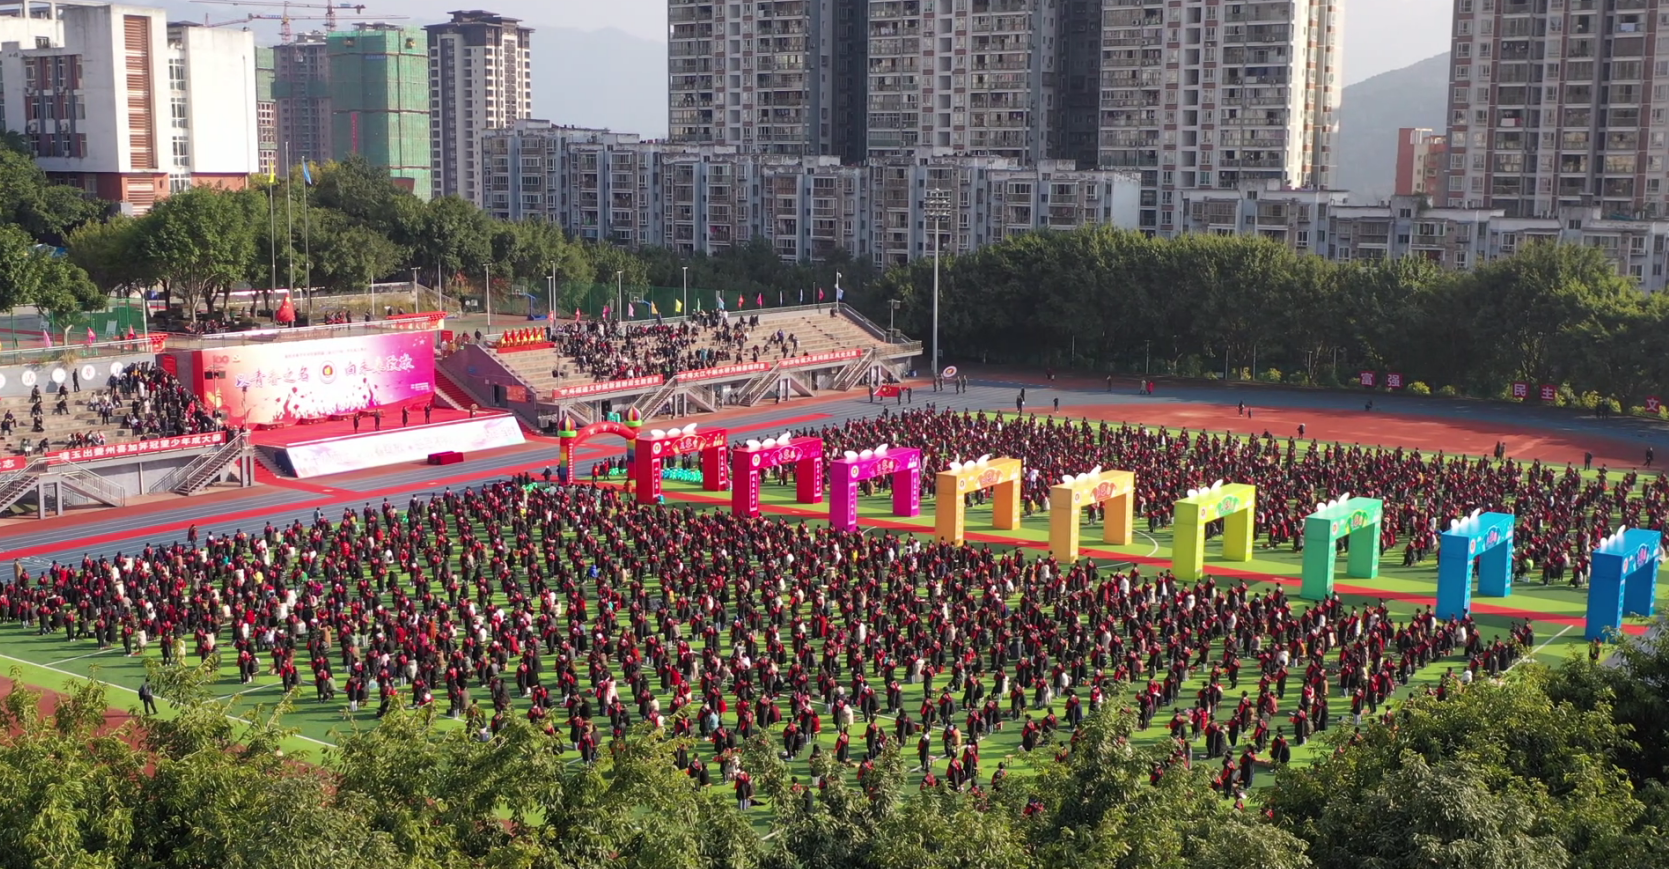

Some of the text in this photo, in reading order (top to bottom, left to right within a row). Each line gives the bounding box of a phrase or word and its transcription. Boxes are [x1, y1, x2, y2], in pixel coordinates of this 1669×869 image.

[235, 365, 309, 388] 以青春之名
[1646, 397, 1659, 412] 文
